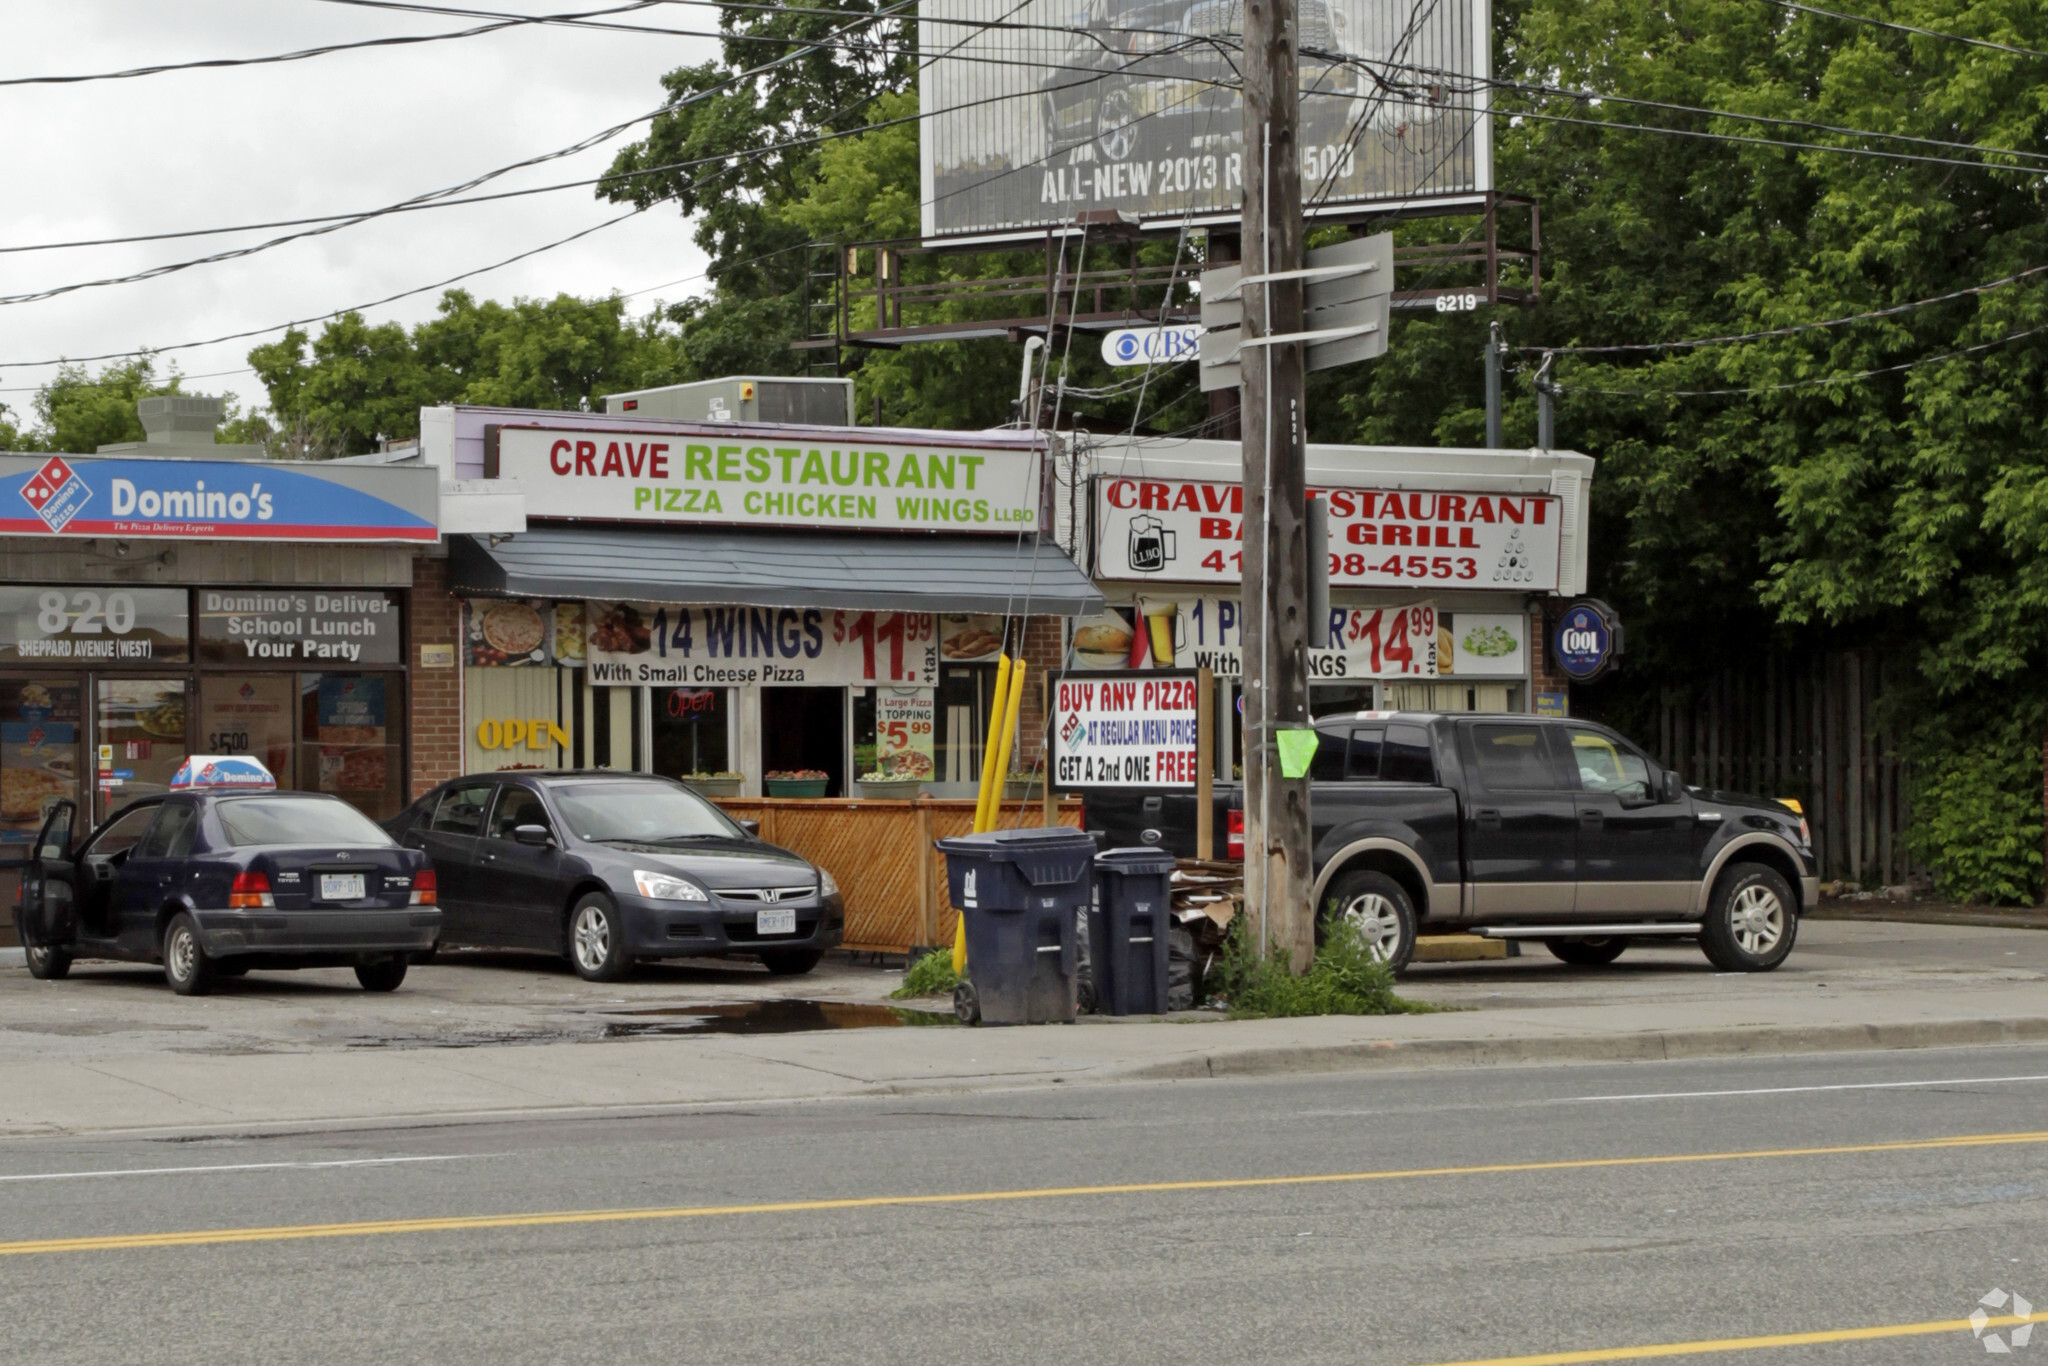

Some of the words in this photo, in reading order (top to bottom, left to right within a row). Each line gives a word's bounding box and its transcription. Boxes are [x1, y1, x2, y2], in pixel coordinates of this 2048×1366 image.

[1041, 161, 1152, 203] ALL-NEW
[1159, 156, 1217, 194] 2013
[1435, 295, 1477, 311] 6219
[1144, 328, 1197, 359] CBS
[550, 439, 669, 479] CRAVE
[684, 444, 984, 490] RESTAURANT
[43, 481, 80, 519] Domino's
[112, 477, 274, 520] Domino's
[635, 487, 723, 514] PIZZA
[743, 491, 876, 519] CHICKEN
[896, 497, 989, 523] WINGS
[994, 509, 1034, 523] LLBO
[51, 503, 75, 528] Pizza
[114, 522, 128, 531] The
[130, 522, 150, 531] Pizza
[152, 523, 184, 533] Delivery
[186, 524, 215, 533] Experts
[1346, 523, 1480, 549] GRILL
[1133, 546, 1161, 565] LLBO
[37, 590, 136, 634] 820
[207, 593, 308, 613] Domino's
[315, 594, 391, 614] Deliver
[227, 616, 302, 635] School
[311, 617, 376, 636] Lunch
[653, 607, 693, 658] 14
[703, 607, 823, 659] WINGS
[18, 639, 72, 657] SHEPPARD
[74, 639, 115, 657] AVENUE
[116, 638, 152, 660] (WEST)
[244, 638, 295, 657] Your
[302, 639, 361, 662] Party
[1561, 628, 1599, 654] COOL
[593, 664, 632, 681] With
[638, 663, 687, 682] Small
[693, 664, 757, 682] Cheese
[762, 664, 805, 682] Pizza
[1194, 651, 1240, 674] With
[667, 689, 715, 717] Open
[884, 698, 908, 709] Large
[910, 698, 932, 707] Pizza
[1059, 683, 1094, 712] BUY
[1100, 682, 1136, 712] ANY
[1143, 680, 1196, 711] PIZZA
[885, 710, 932, 720] TOPPING
[477, 718, 570, 750] OPEN
[1087, 721, 1098, 746] AT
[1100, 720, 1139, 746] REGULAR
[1142, 720, 1167, 745] MENU
[1170, 719, 1196, 745] PRICE
[223, 771, 271, 783] Domino's
[1059, 755, 1082, 782] GET
[1085, 756, 1094, 782] A
[1098, 756, 1120, 782] 2nd
[1125, 756, 1150, 782] ONE
[1156, 751, 1196, 782] FREE
